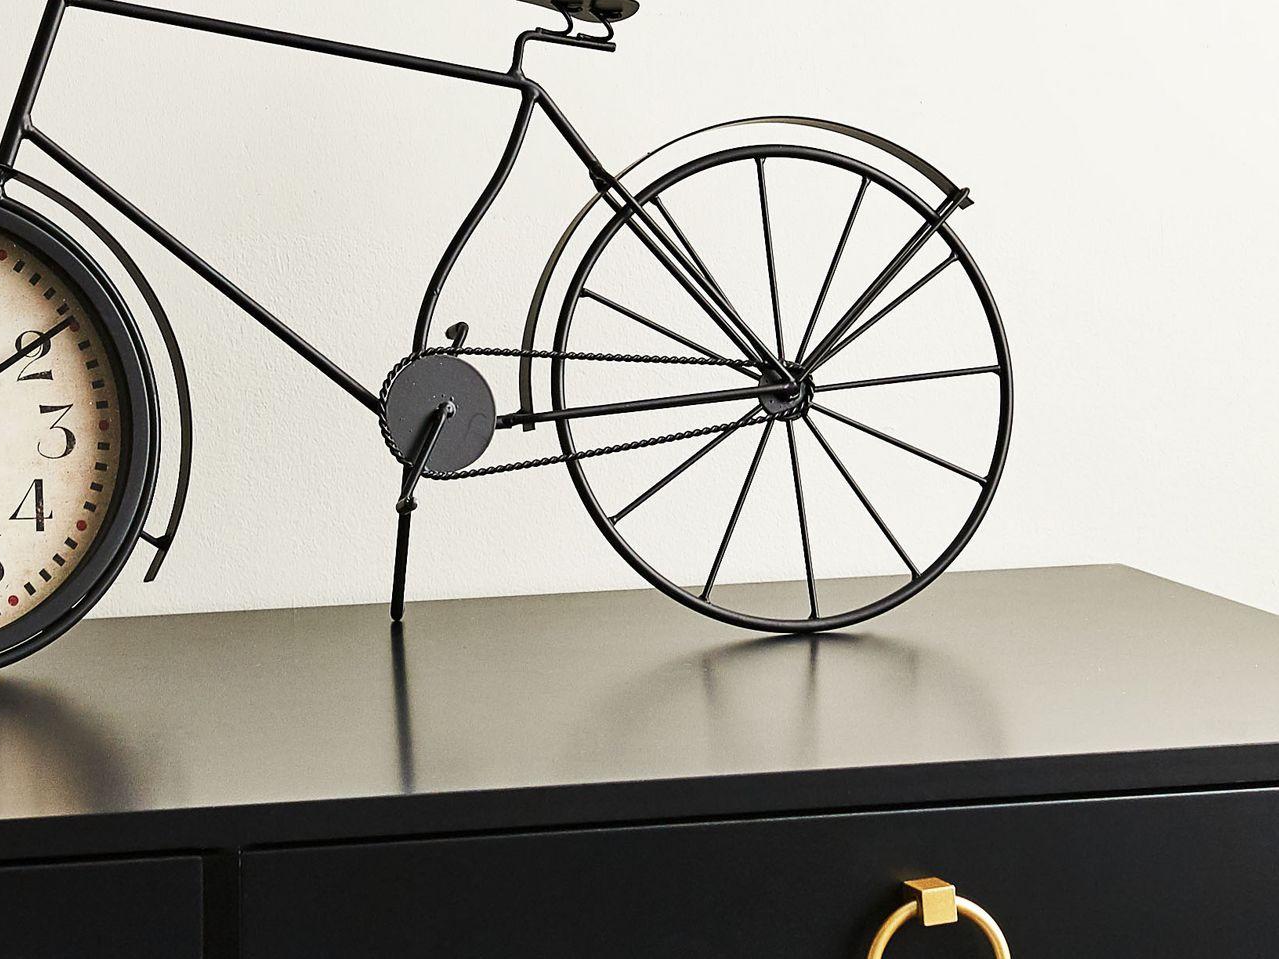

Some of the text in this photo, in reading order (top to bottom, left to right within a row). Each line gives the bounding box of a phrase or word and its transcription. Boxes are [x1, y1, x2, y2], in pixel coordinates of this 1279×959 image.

[14, 330, 54, 382] 2
[37, 403, 77, 460] 3
[8, 478, 54, 533] 4
